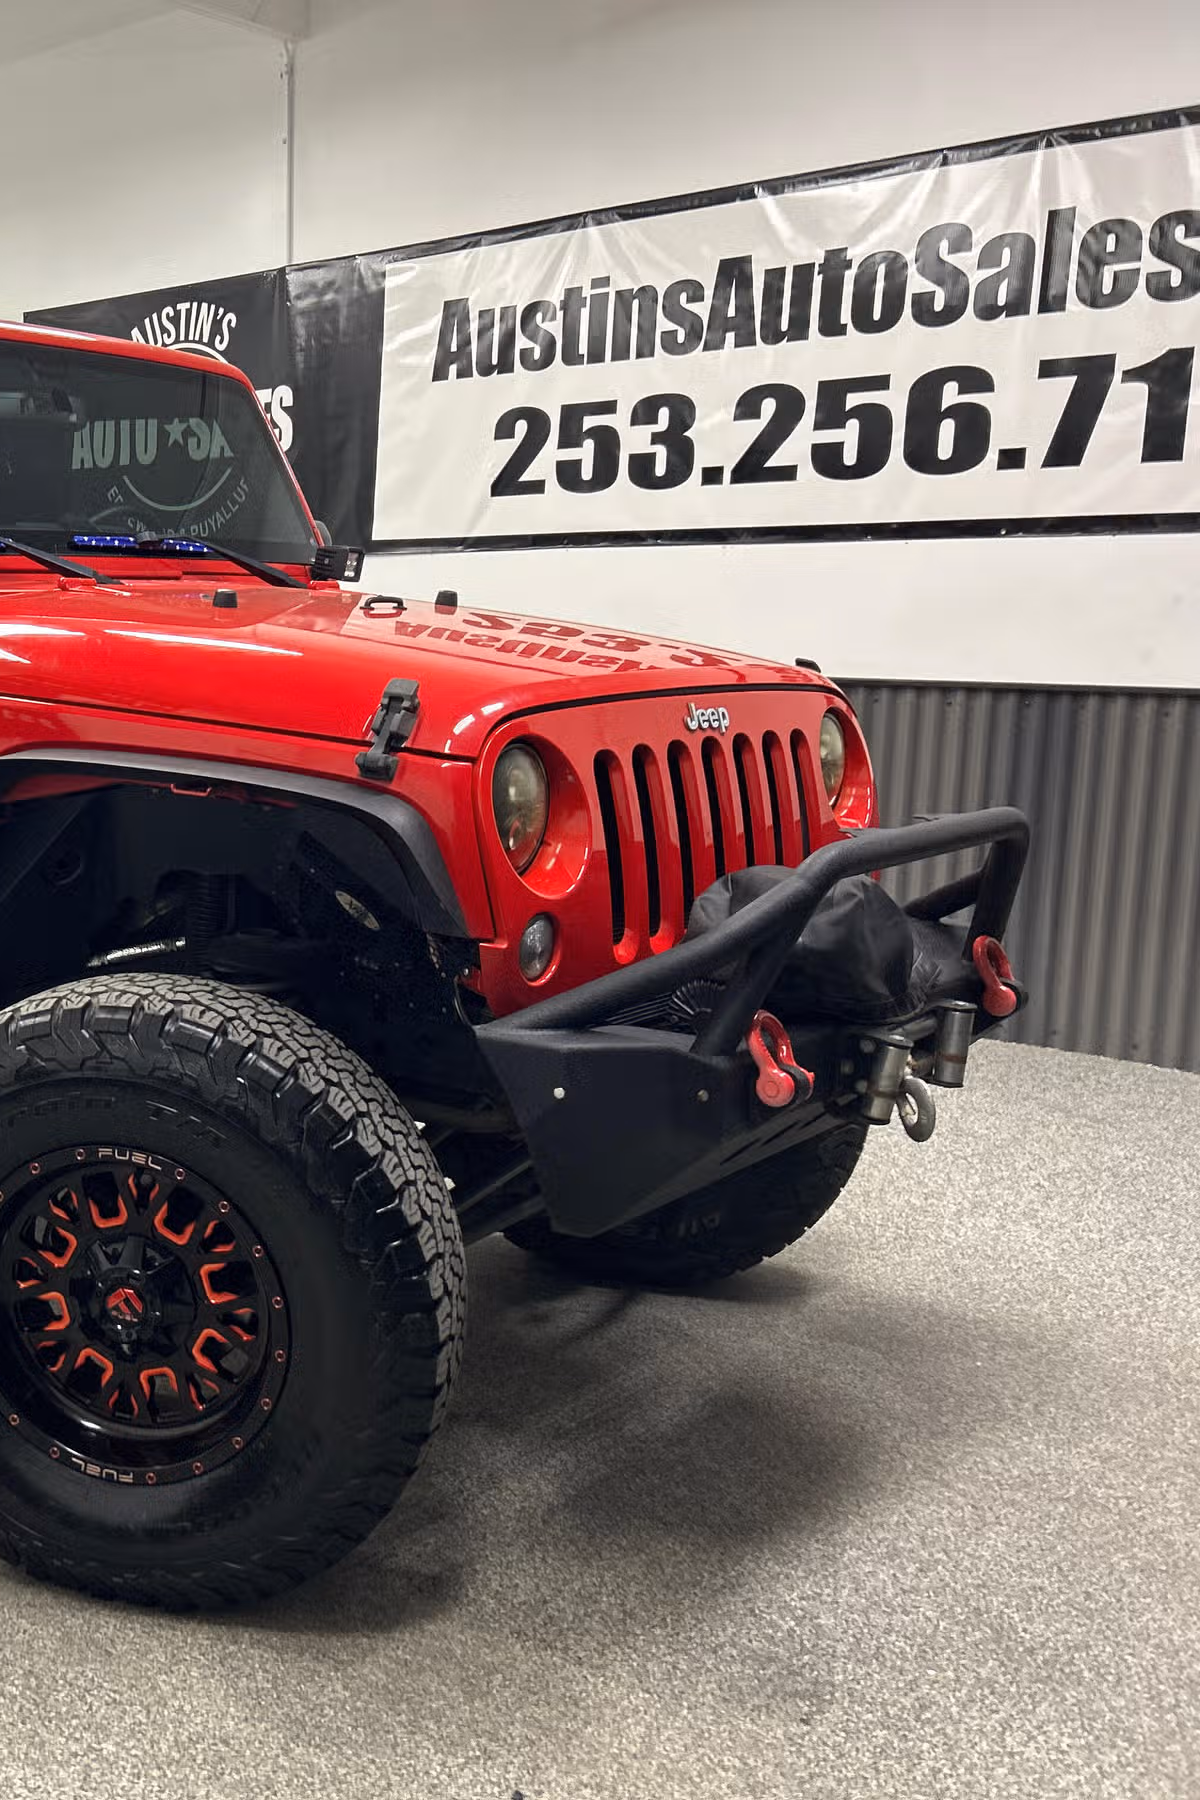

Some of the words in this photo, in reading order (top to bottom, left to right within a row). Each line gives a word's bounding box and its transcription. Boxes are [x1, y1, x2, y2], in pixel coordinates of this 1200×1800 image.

[431, 206, 1200, 383] AustinsAutoSales
[130, 301, 237, 351] AUSTIN'S
[490, 346, 1196, 498] 253.256.71
[683, 701, 730, 734] Jeep
[98, 1147, 163, 1171] FUEL
[71, 1457, 134, 1484] FUEL
